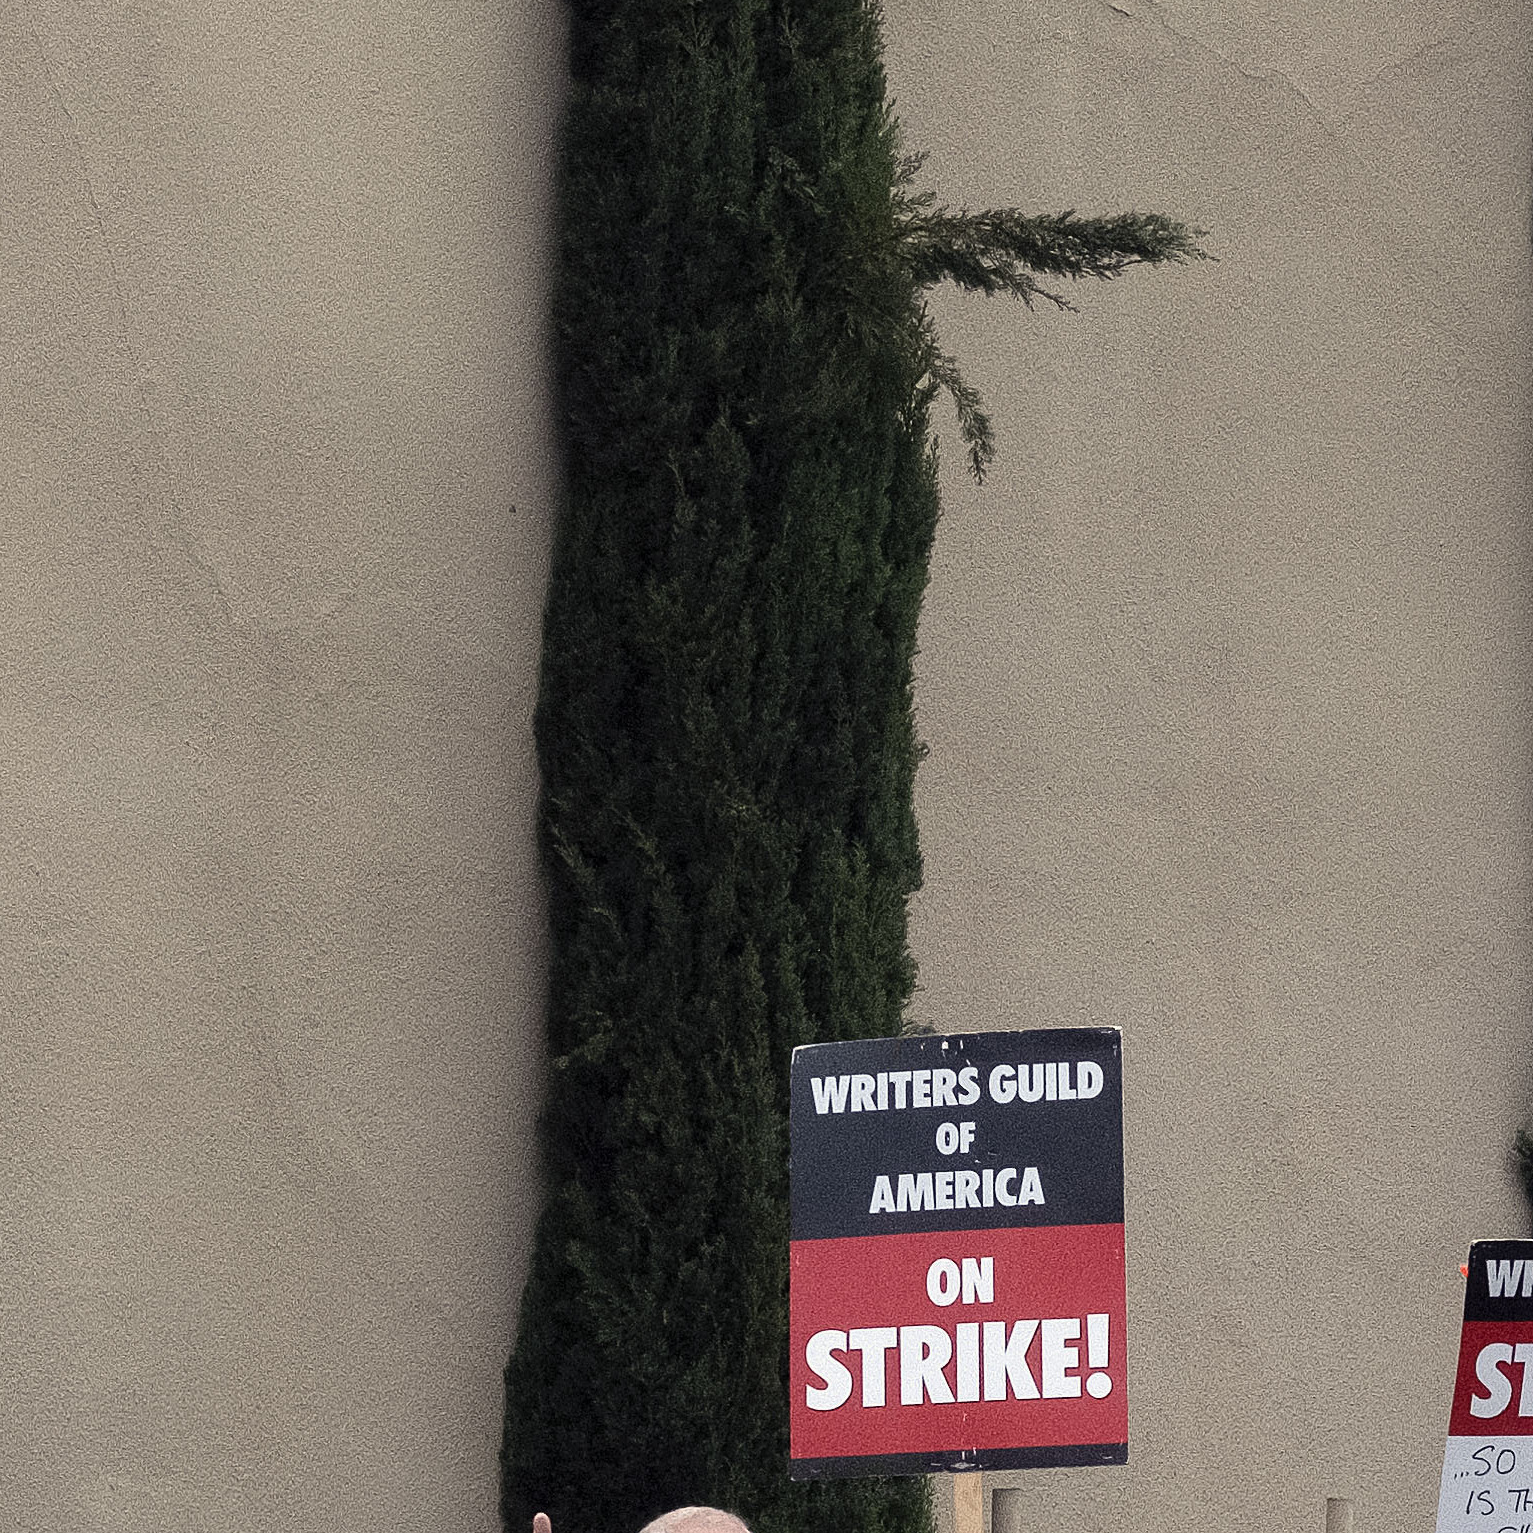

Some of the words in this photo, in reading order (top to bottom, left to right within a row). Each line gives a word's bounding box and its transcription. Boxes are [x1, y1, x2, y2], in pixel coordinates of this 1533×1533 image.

[811, 1066, 981, 1114] WRITERS
[989, 1061, 1104, 1104] GUILD
[936, 1122, 976, 1155] OF
[870, 1167, 1045, 1214] AMERICA
[926, 1257, 995, 1307] ON
[805, 1313, 1113, 1411] STRIKE!
[1466, 1490, 1494, 1516] IS
